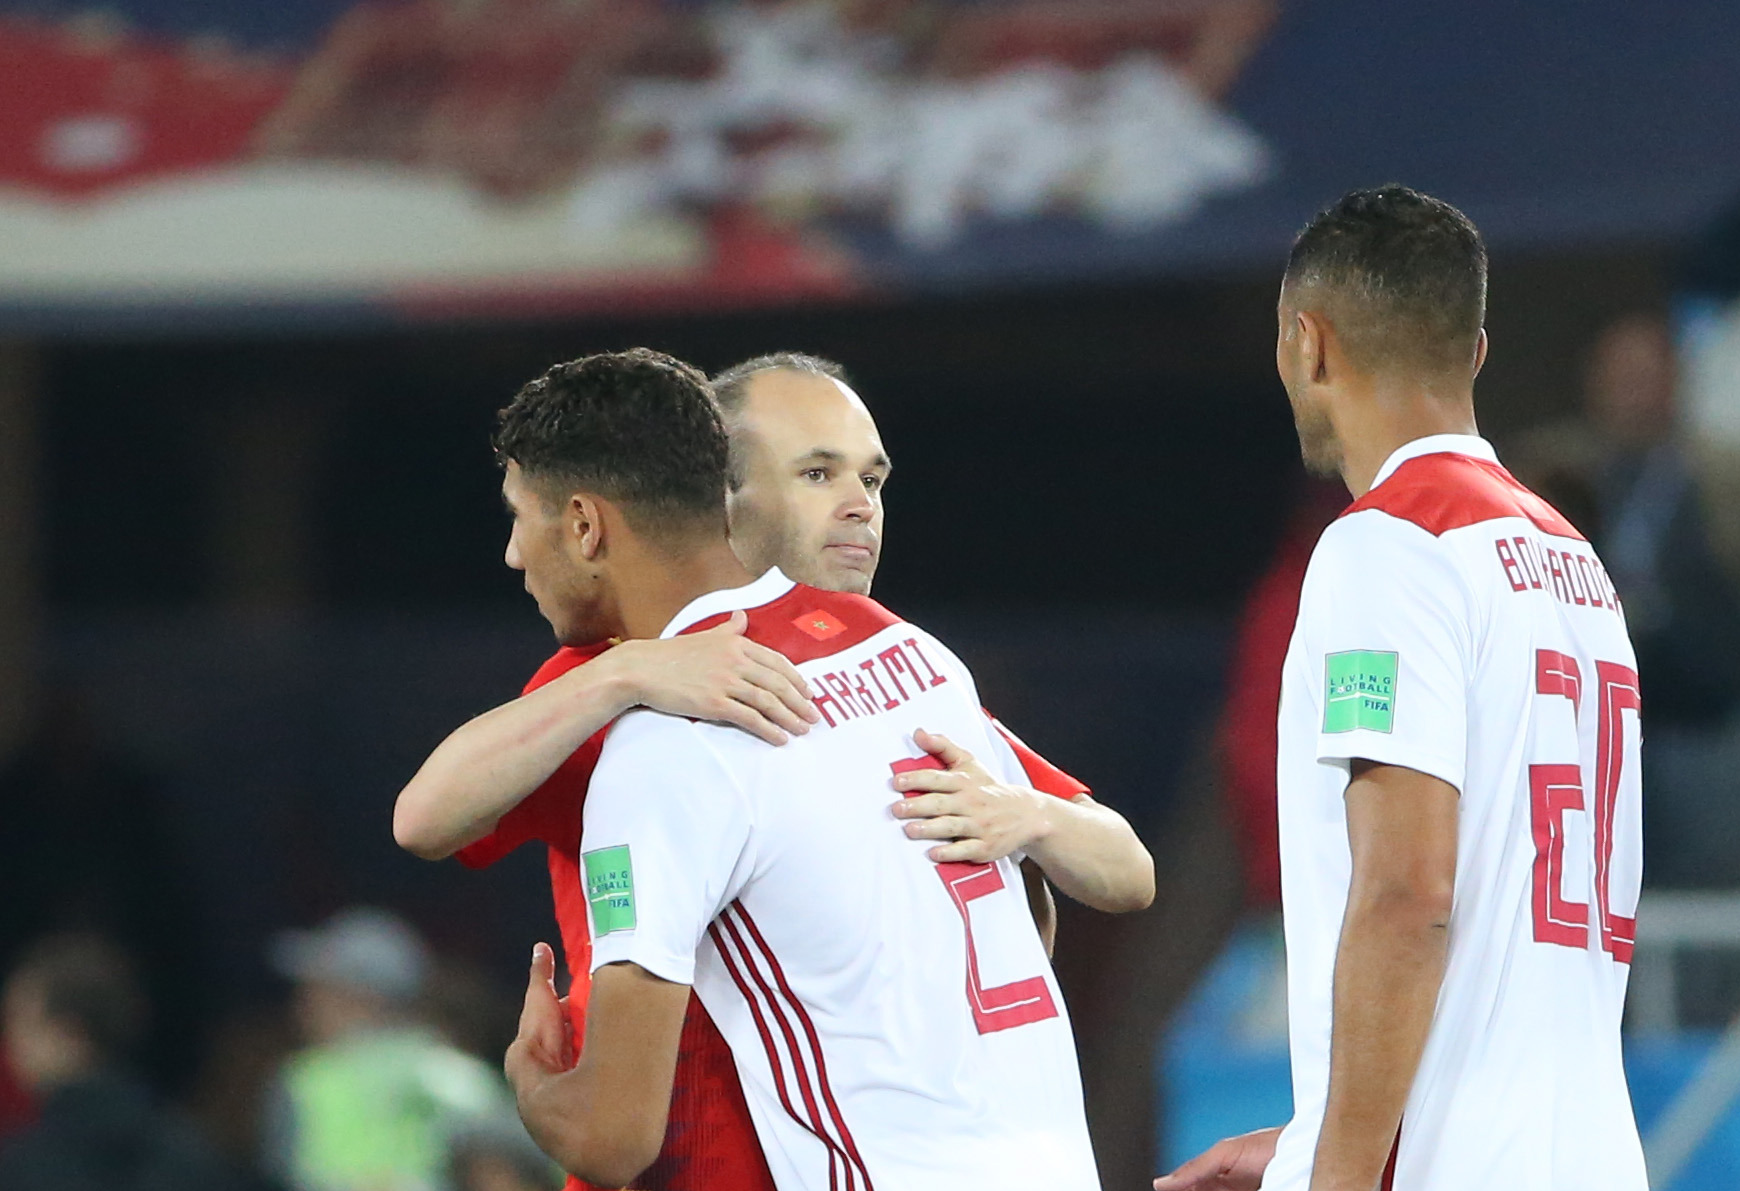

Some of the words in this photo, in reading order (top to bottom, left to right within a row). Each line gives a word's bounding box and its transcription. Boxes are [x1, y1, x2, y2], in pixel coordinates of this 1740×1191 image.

[1330, 673, 1391, 686] LIVING
[1364, 700, 1389, 711] FIFA
[1528, 648, 1642, 964] 20
